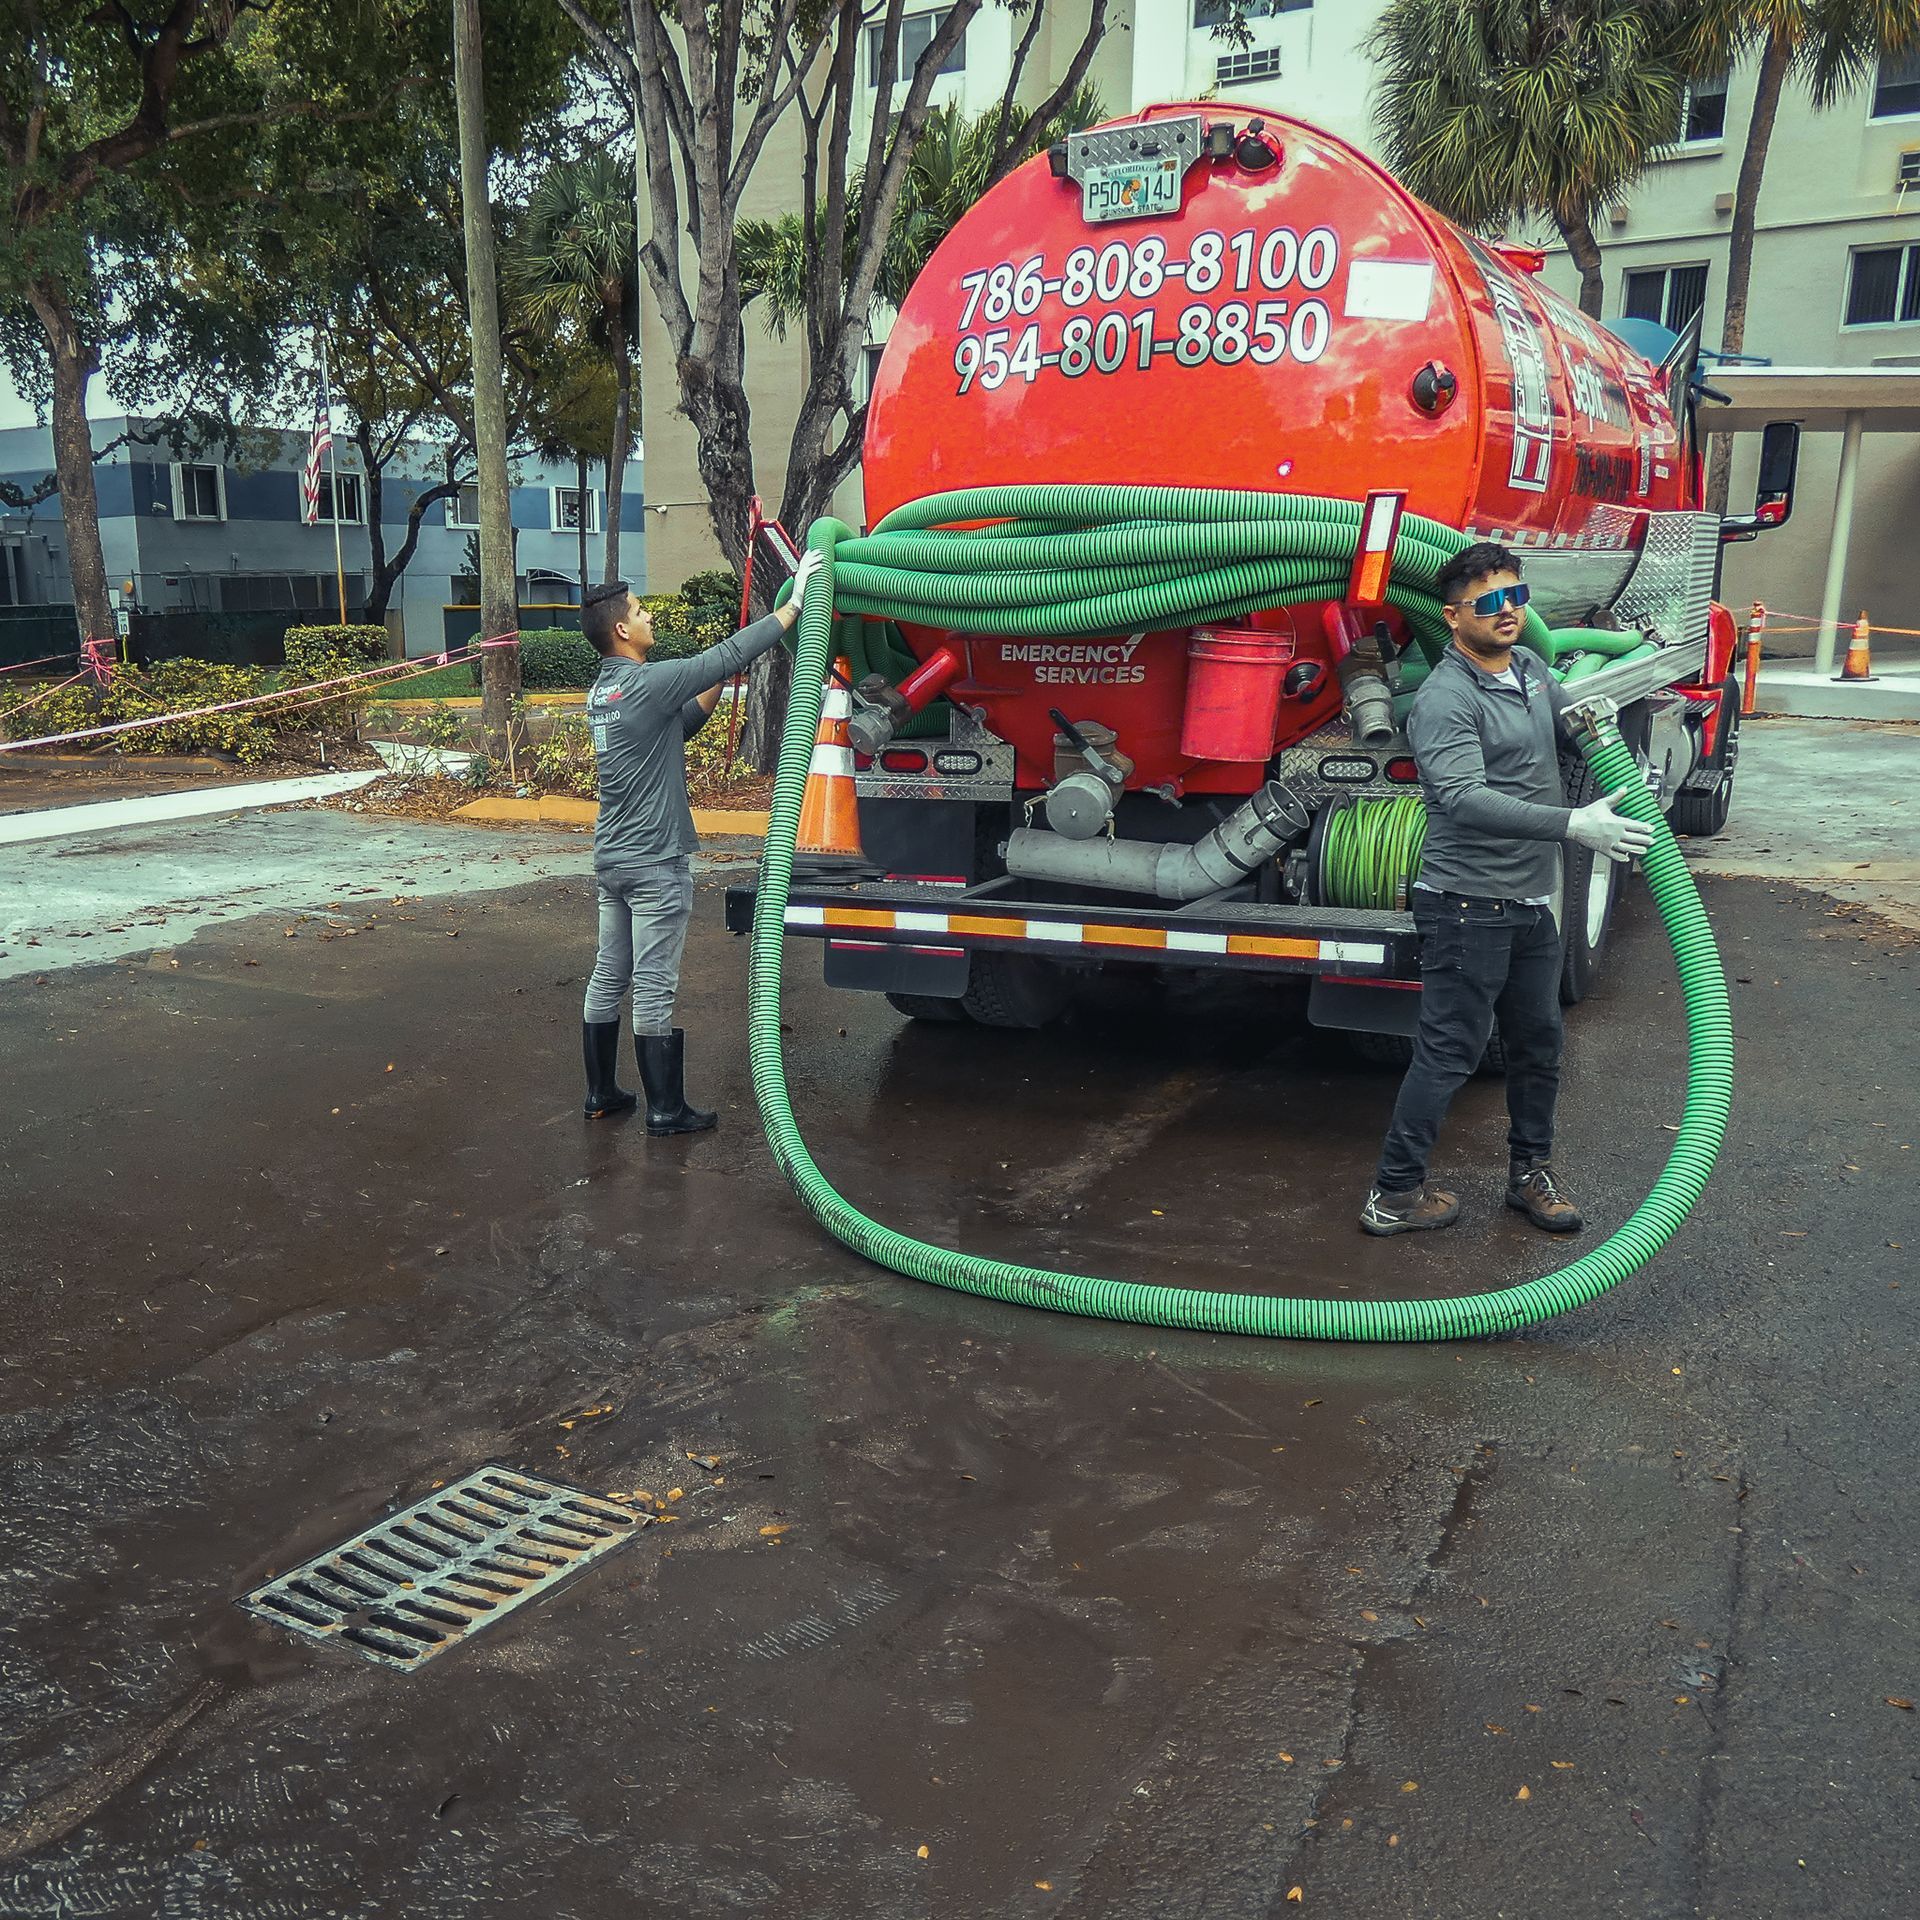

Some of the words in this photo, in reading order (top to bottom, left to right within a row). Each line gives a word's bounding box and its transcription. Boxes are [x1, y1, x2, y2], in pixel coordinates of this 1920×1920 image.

[1089, 180, 1120, 209] P50
[1144, 173, 1175, 202] 14J
[958, 226, 1339, 332] 786-808-8100
[954, 298, 1333, 396] 954-801-8850
[1001, 644, 1137, 663] EMERGENCY
[1035, 666, 1145, 684] SERVICES
